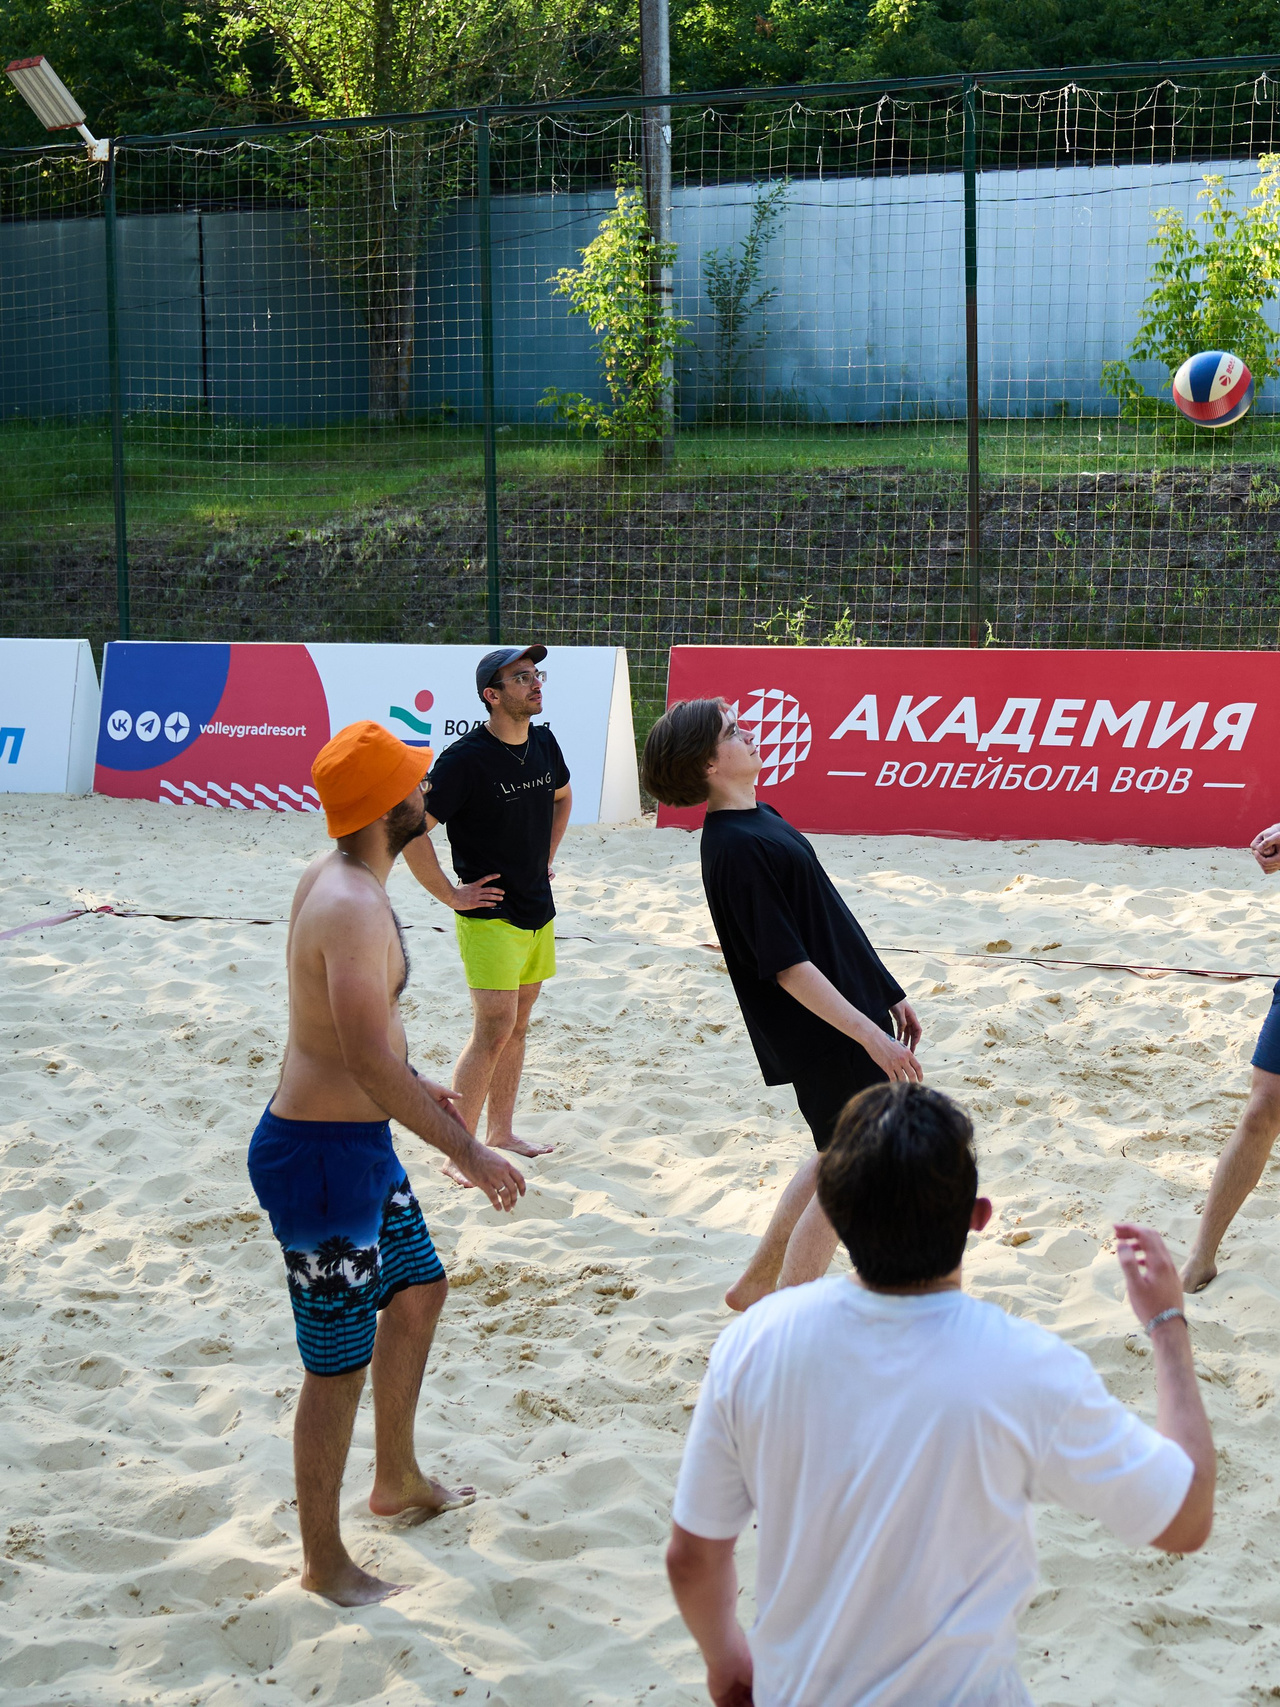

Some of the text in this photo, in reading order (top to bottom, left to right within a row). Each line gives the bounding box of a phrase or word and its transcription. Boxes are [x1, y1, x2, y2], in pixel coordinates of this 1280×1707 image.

[199, 721, 307, 738] volleygradresort
[828, 694, 1257, 752] АКАДЕМИЯ
[500, 771, 552, 795] LI-NING
[875, 757, 1194, 794] ВОЛЕЙБОЛА ВФВ
